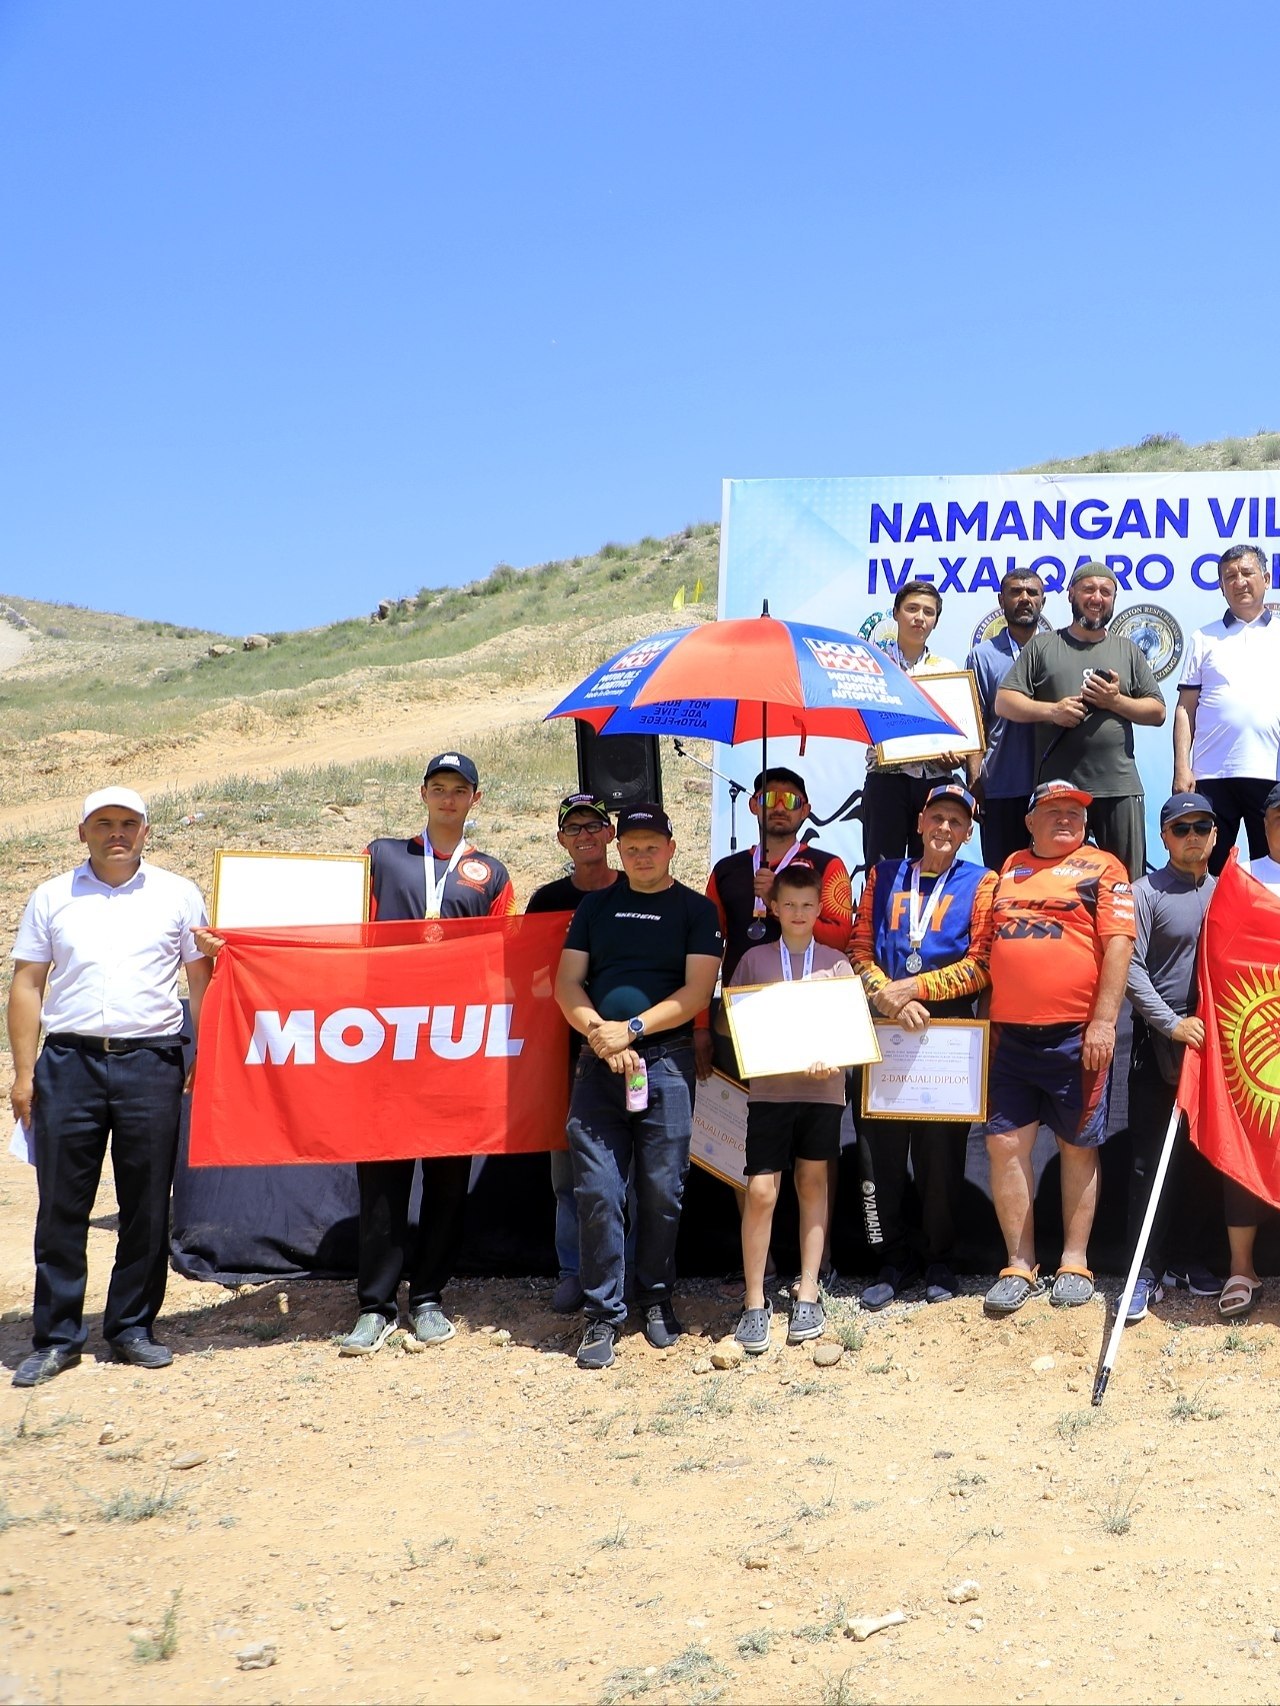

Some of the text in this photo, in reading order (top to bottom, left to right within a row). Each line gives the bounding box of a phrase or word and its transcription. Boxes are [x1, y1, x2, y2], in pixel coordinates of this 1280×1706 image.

[869, 498, 1189, 543] NAMANGAN
[808, 638, 871, 655] LIQUI
[613, 651, 660, 669] MOLY
[817, 651, 880, 674] MOLY
[837, 682, 889, 696] ADDITIVE
[1065, 858, 1101, 871] KTM
[615, 912, 661, 921] SKECHERS
[890, 891, 954, 931] FY
[996, 917, 1064, 940] KTM
[244, 1003, 525, 1065] MOTUL
[881, 1073, 969, 1084] 2-DARAJALI DIPLOM
[721, 1133, 746, 1152] DIPLO
[863, 1194, 884, 1244] YAMAHA
